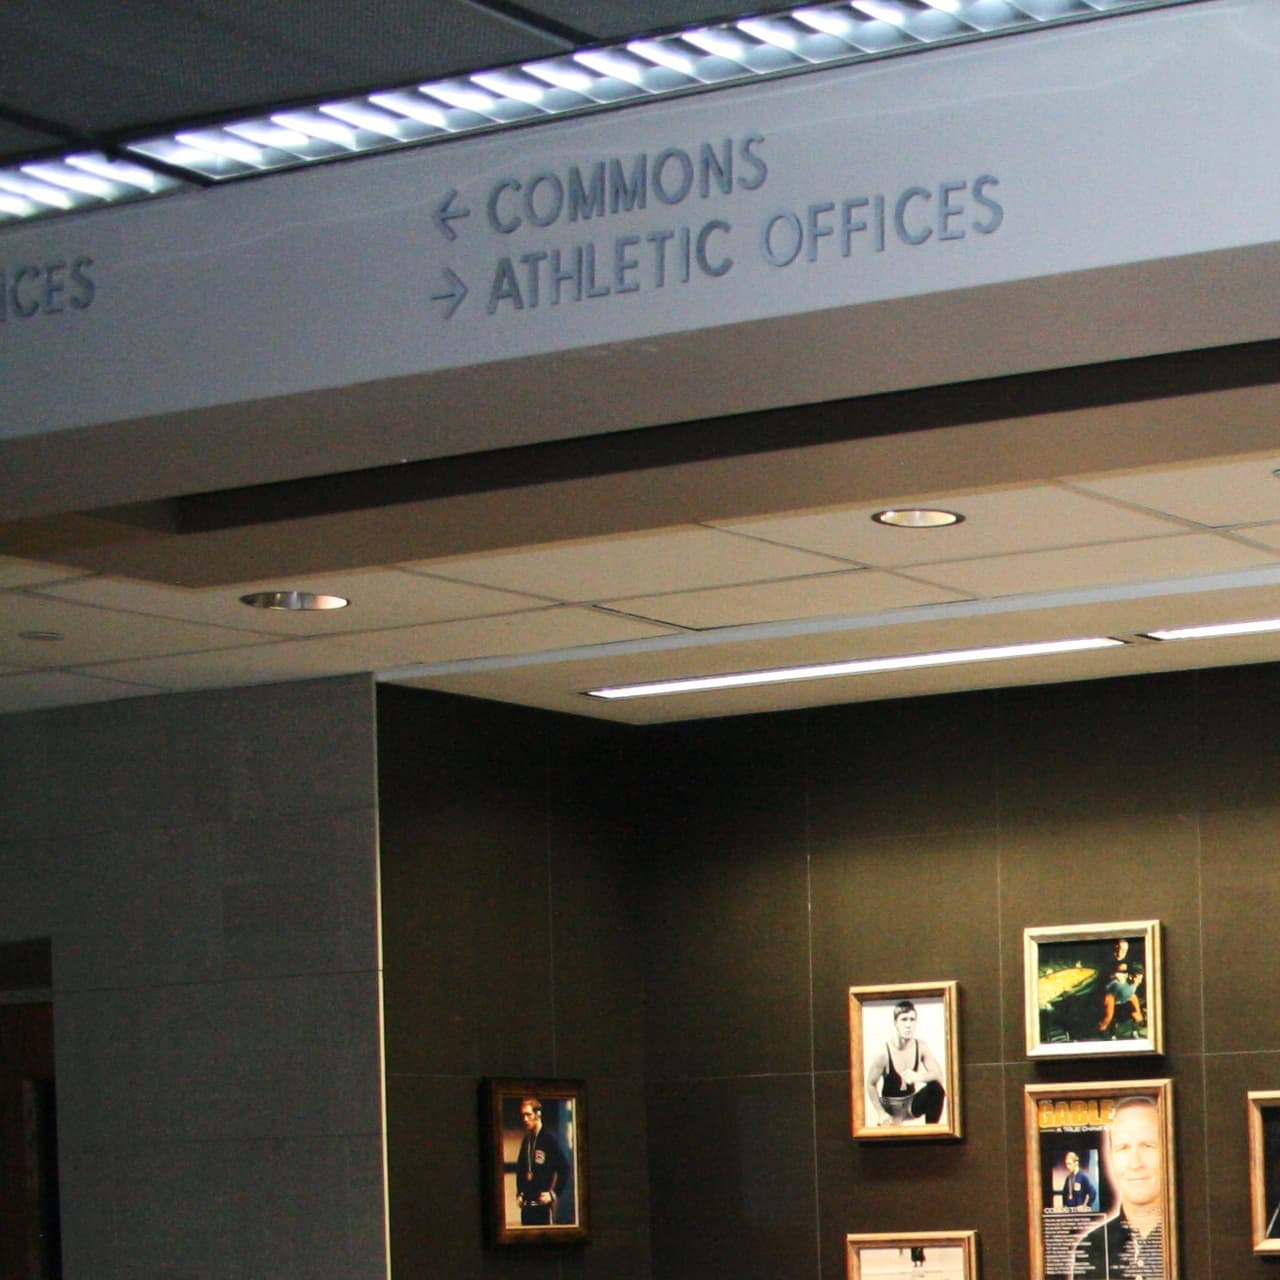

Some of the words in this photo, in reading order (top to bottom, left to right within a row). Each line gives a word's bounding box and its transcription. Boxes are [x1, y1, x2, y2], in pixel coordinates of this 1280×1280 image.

[486, 133, 768, 235] COMMONS
[486, 218, 733, 315] ATHLETIC
[762, 173, 1006, 268] OFFICES
